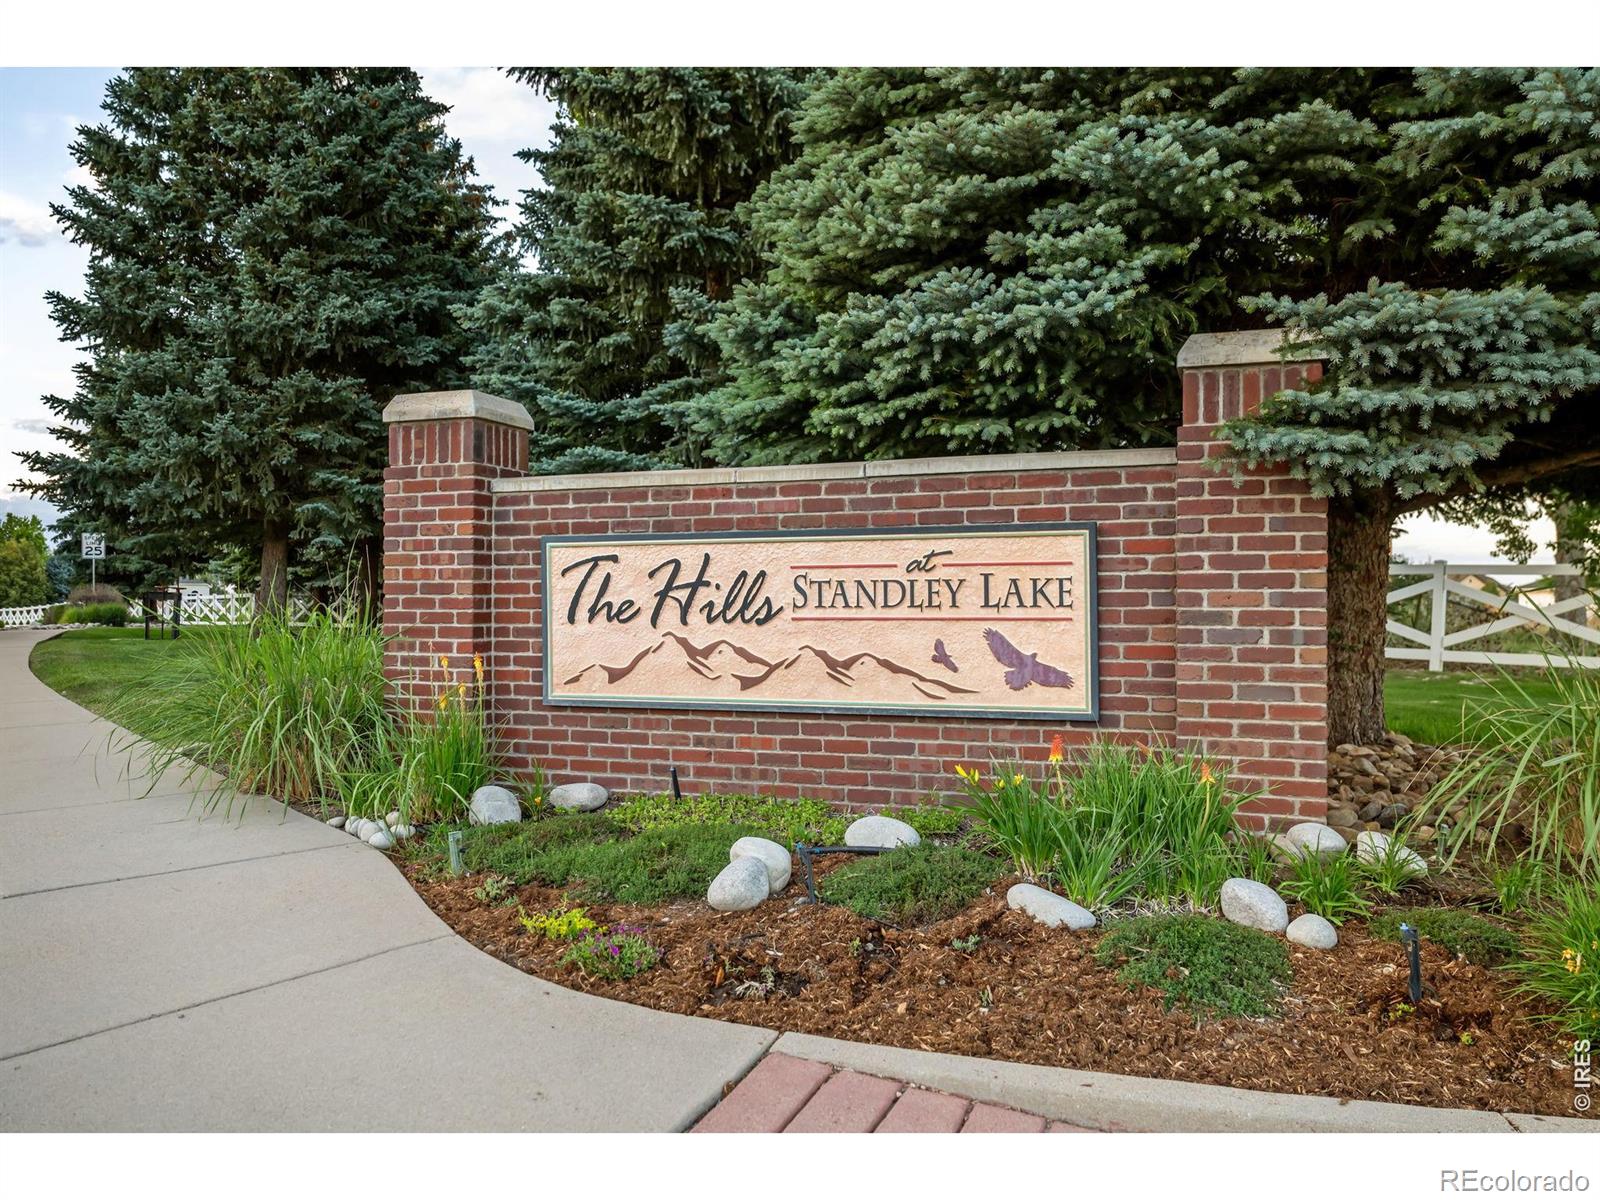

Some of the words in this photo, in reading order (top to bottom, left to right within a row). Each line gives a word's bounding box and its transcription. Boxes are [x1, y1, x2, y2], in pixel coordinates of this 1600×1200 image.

[85, 546, 103, 556] 25
[905, 549, 953, 573] at
[561, 554, 641, 625] The
[648, 552, 783, 629] Hills
[792, 572, 966, 613] STANDLEY
[980, 572, 1074, 613] LAKE
